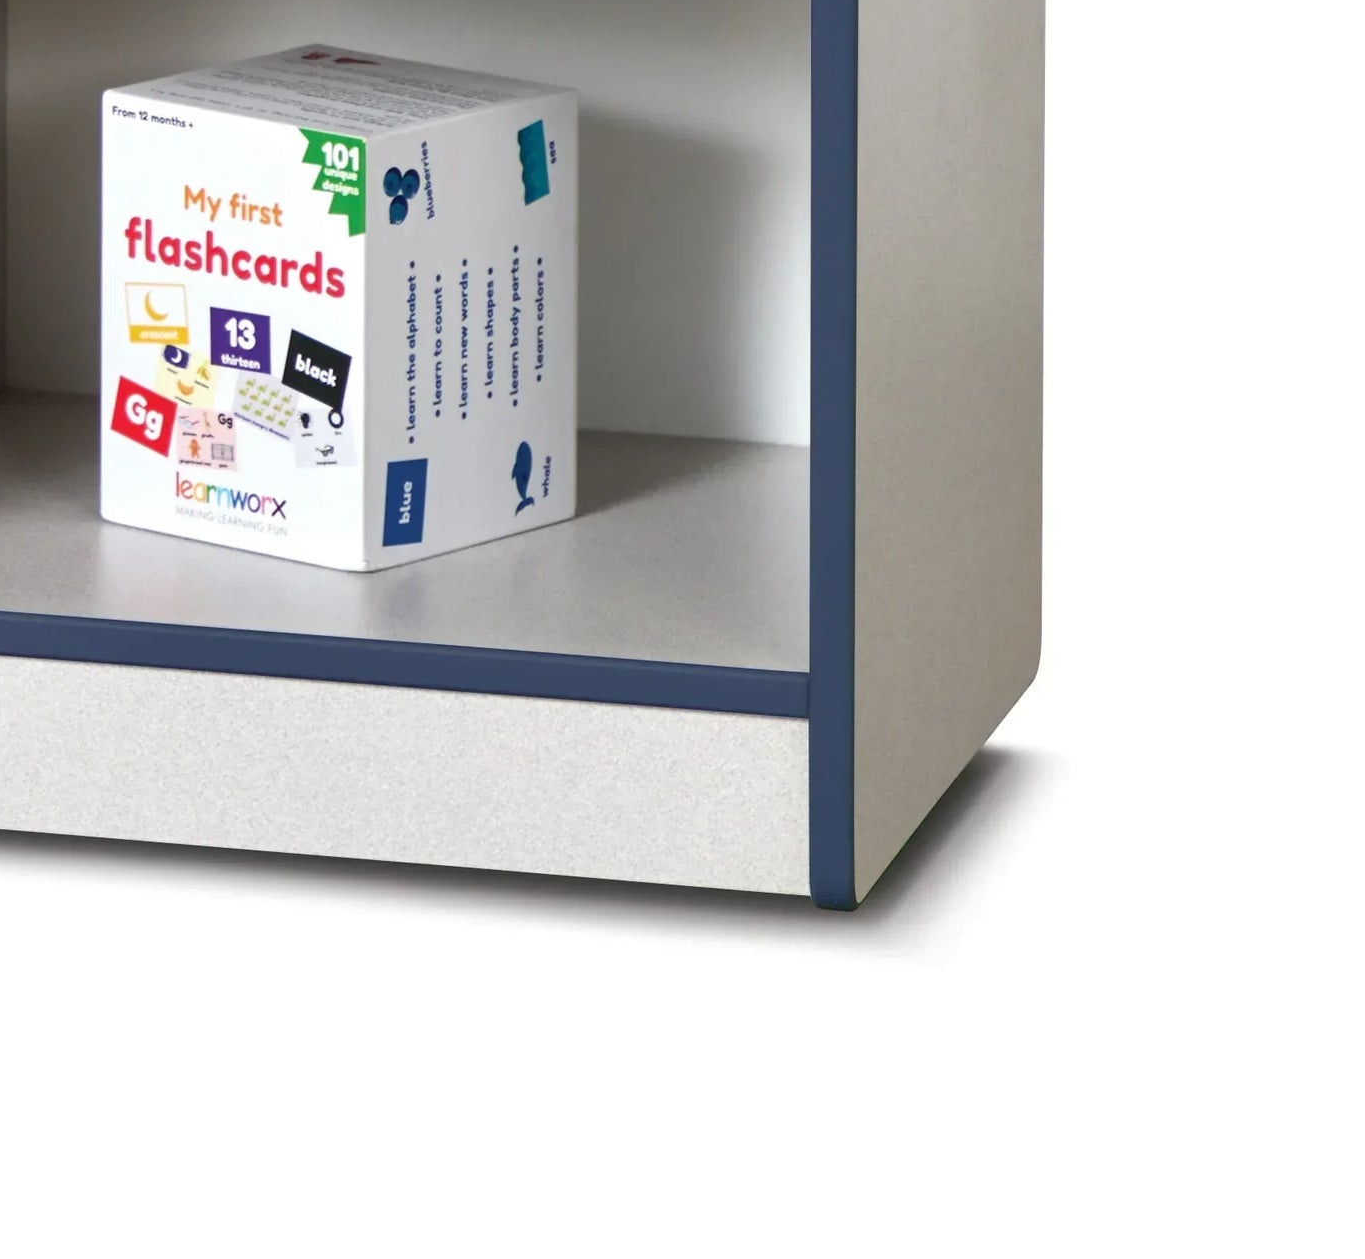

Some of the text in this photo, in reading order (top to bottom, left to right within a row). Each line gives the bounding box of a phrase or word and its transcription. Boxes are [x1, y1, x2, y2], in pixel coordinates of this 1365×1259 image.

[112, 105, 136, 120] From
[138, 110, 148, 122] 12
[150, 114, 187, 129] months
[321, 141, 360, 171] 101
[323, 167, 359, 182] unique
[548, 140, 557, 165] sea
[321, 180, 360, 197] designs
[420, 140, 436, 220] blueberries
[184, 184, 284, 228] My first
[124, 216, 346, 299] flashcards
[224, 317, 257, 351] 13
[458, 272, 469, 408] learn new words
[484, 280, 496, 388] learn shapes
[509, 257, 522, 396] learn body parts
[534, 270, 545, 373] learn colors
[221, 353, 261, 370] thirteen
[406, 275, 417, 431] learn the alphabet
[433, 286, 443, 407] learn to count
[294, 353, 337, 388] black
[125, 393, 164, 442] Gg
[217, 412, 234, 430] Gg
[175, 471, 287, 520] learnworx
[542, 455, 552, 498] whale
[175, 505, 288, 537] MAKING LEARNING FUN
[398, 481, 413, 525] blue
